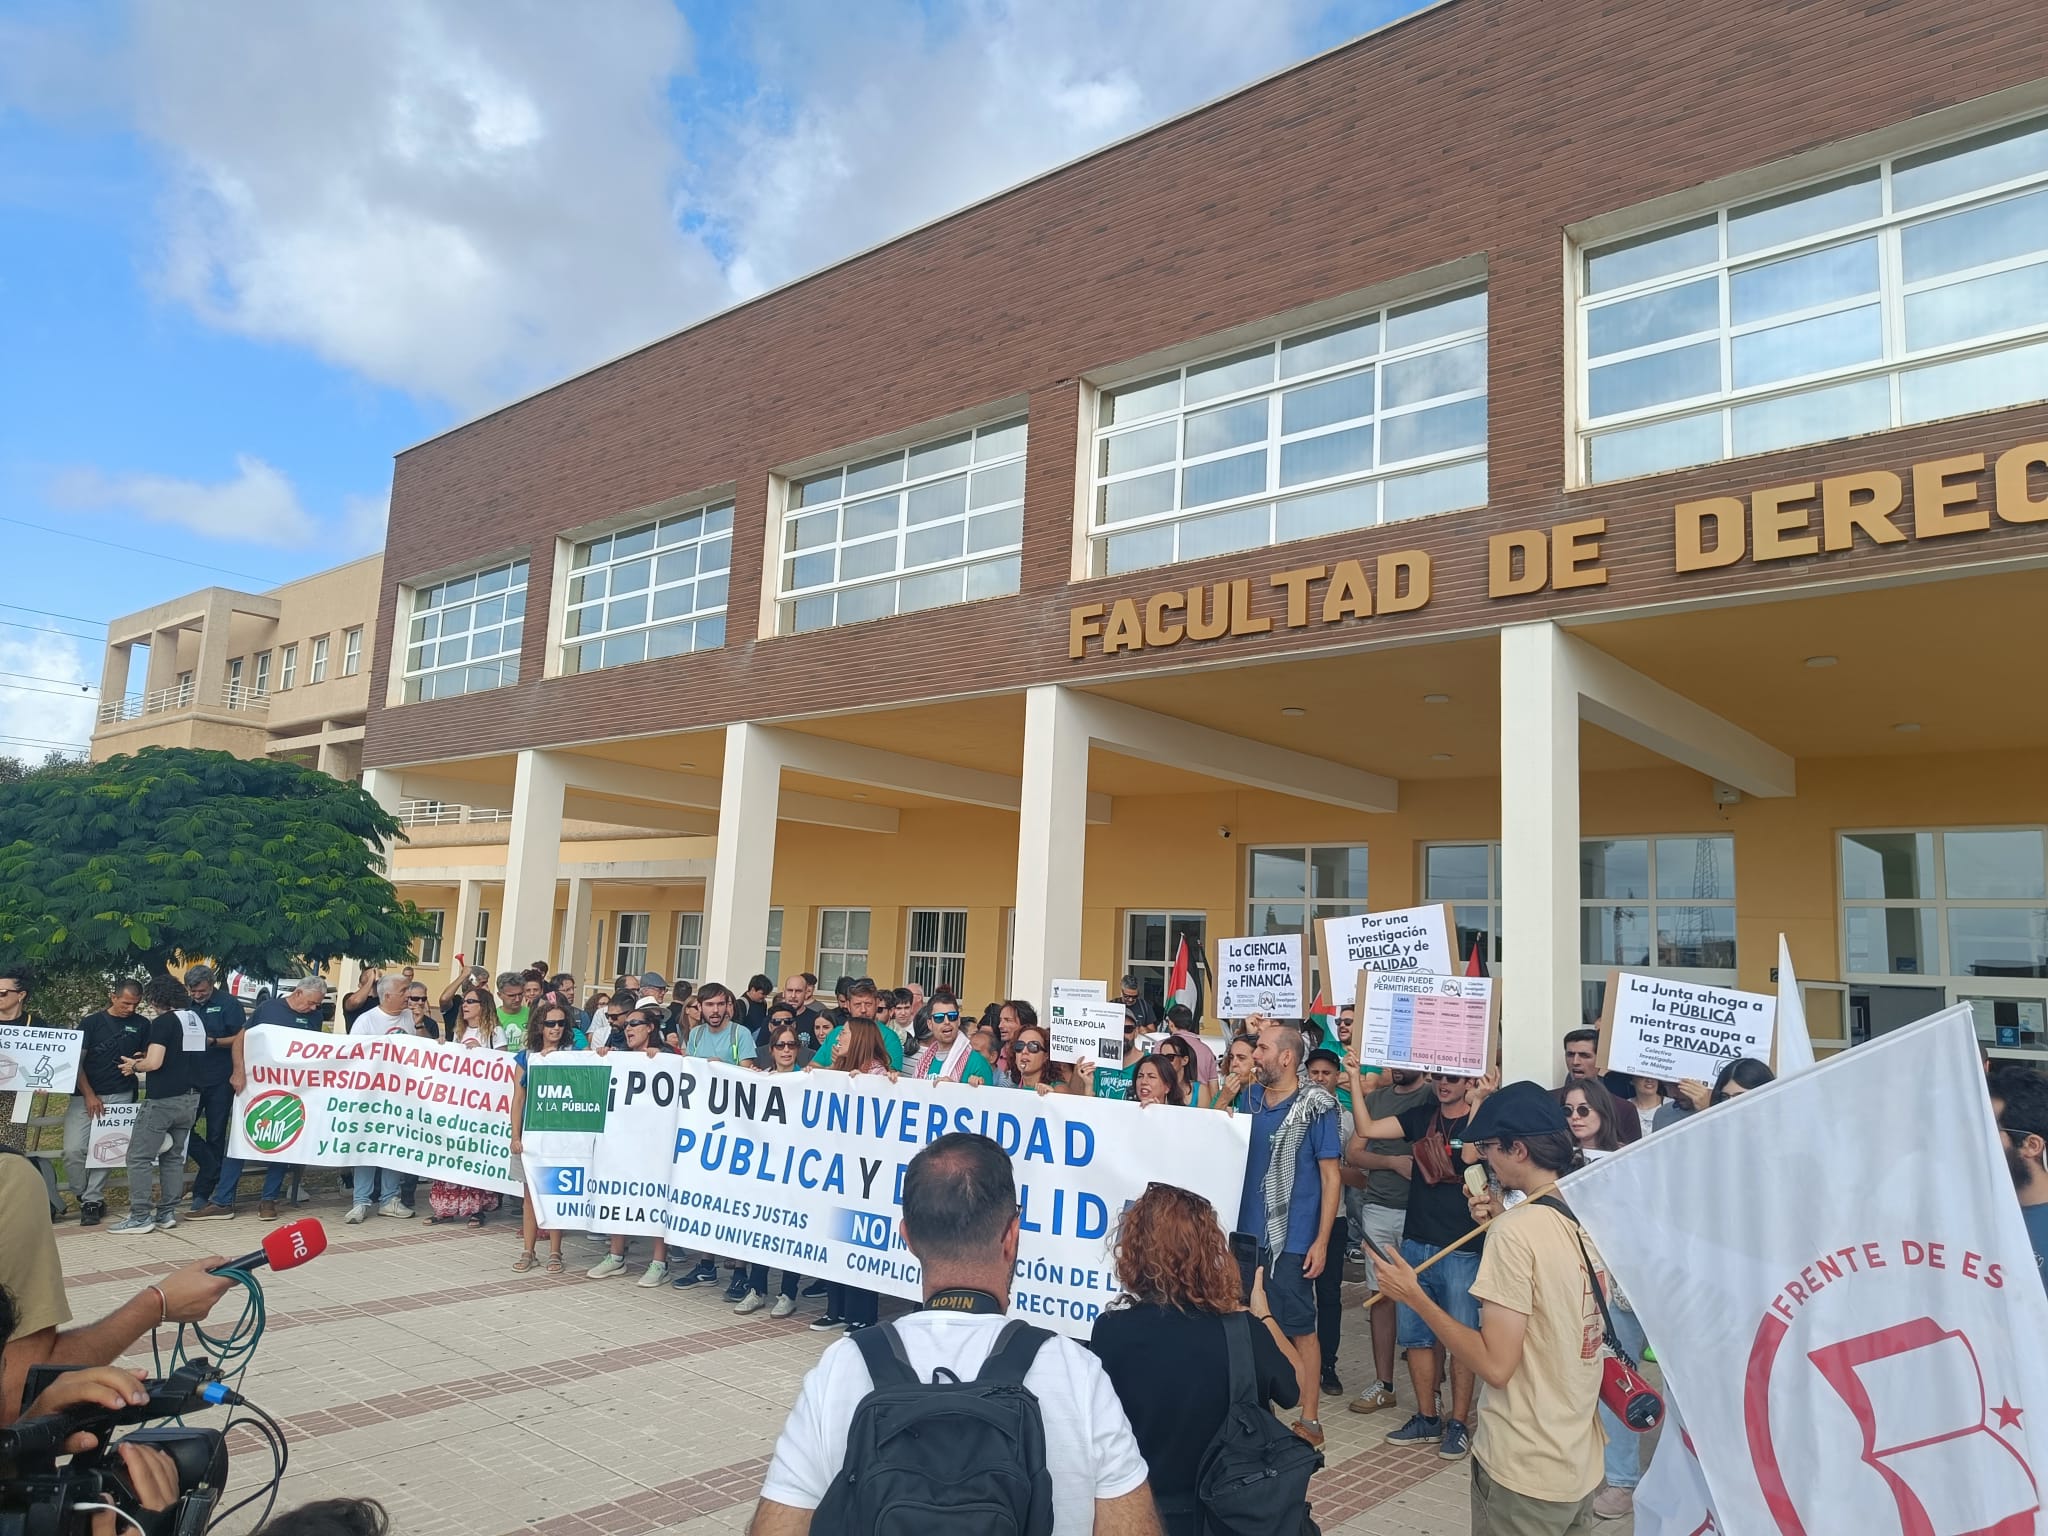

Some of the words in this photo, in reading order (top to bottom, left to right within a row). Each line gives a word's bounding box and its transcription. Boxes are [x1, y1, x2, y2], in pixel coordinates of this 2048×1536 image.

[1069, 550, 1433, 659] FACULTAD
[1488, 516, 1609, 600] DE
[1675, 441, 2048, 574] DEREC
[1361, 917, 1382, 928] Por
[1385, 915, 1409, 925] una
[1347, 926, 1427, 945] investigación
[1229, 945, 1242, 957] La
[1244, 942, 1287, 956] CIENCIA
[1348, 943, 1401, 959] PÚBLICA
[1403, 945, 1411, 956] y
[1414, 940, 1430, 952] de
[1229, 964, 1242, 972] no
[1244, 963, 1255, 972] se
[1258, 958, 1290, 972] firma,
[1363, 956, 1418, 971] CALIDAD
[1227, 979, 1238, 988] se
[1240, 973, 1293, 988] FINANCIA
[1408, 976, 1434, 985] PUEDE
[1630, 979, 1648, 993] La
[1651, 983, 1693, 1000] Junta
[1697, 991, 1748, 1010] ahoga
[1752, 1001, 1763, 1012] a
[1652, 999, 1666, 1012] la
[1669, 1000, 1736, 1024] PÚBLICA
[1052, 1018, 1073, 1026] JUNTA
[1074, 1020, 1106, 1029] EXPOLIA
[1630, 1014, 1696, 1034] mientras
[1700, 1027, 1741, 1042] aupa
[1745, 1034, 1756, 1045] a
[23, 1029, 78, 1041] CEMENTO
[1052, 1034, 1078, 1044] RECTOR
[1080, 1037, 1096, 1046] NOS
[1638, 1029, 1660, 1044] las
[1663, 1034, 1743, 1058] PRIVADAS
[15, 1041, 66, 1053] TALENTO
[1052, 1043, 1073, 1053] VENDE
[286, 1040, 334, 1059] POR
[335, 1042, 365, 1060] LA
[369, 1042, 516, 1084] FINANCIACIÓN
[252, 1065, 401, 1093] UNIVERSIDAD
[404, 1075, 492, 1112] PÚBLICA
[537, 1085, 573, 1099] UMA
[104, 1106, 132, 1115] ENOS
[326, 1097, 403, 1117] Derecho
[406, 1108, 414, 1120] a
[418, 1107, 432, 1125] la
[536, 1102, 543, 1112] X
[546, 1103, 558, 1112] LA
[561, 1100, 601, 1113] PÚBLICA
[97, 1117, 120, 1127] MÁS
[708, 1077, 787, 1125] UNA
[801, 1089, 1095, 1167] UNIVERSIDAD
[331, 1117, 359, 1133] los
[364, 1121, 442, 1146] servicios
[446, 1136, 512, 1159] público
[317, 1140, 328, 1155] y
[333, 1138, 351, 1154] la
[356, 1141, 424, 1162] carrera
[427, 1152, 513, 1182] profesion
[672, 1121, 845, 1195] PÚBLICA
[859, 1157, 882, 1200] Y
[558, 1169, 581, 1193] SI
[752, 1204, 809, 1230] JUSTAS
[556, 1200, 596, 1218] UNIÓN
[599, 1205, 620, 1221] DE
[625, 1206, 646, 1223] LA
[715, 1224, 828, 1264] UNIVERSITARIA
[290, 1231, 308, 1259] rne
[851, 1214, 887, 1246] NO
[1070, 1267, 1099, 1290] DE
[1106, 1272, 1124, 1293] L
[1771, 1241, 1887, 1320] FRENTE
[1902, 1240, 1945, 1269] DE
[1962, 1250, 2004, 1289] ES
[932, 1296, 974, 1309] Nikon
